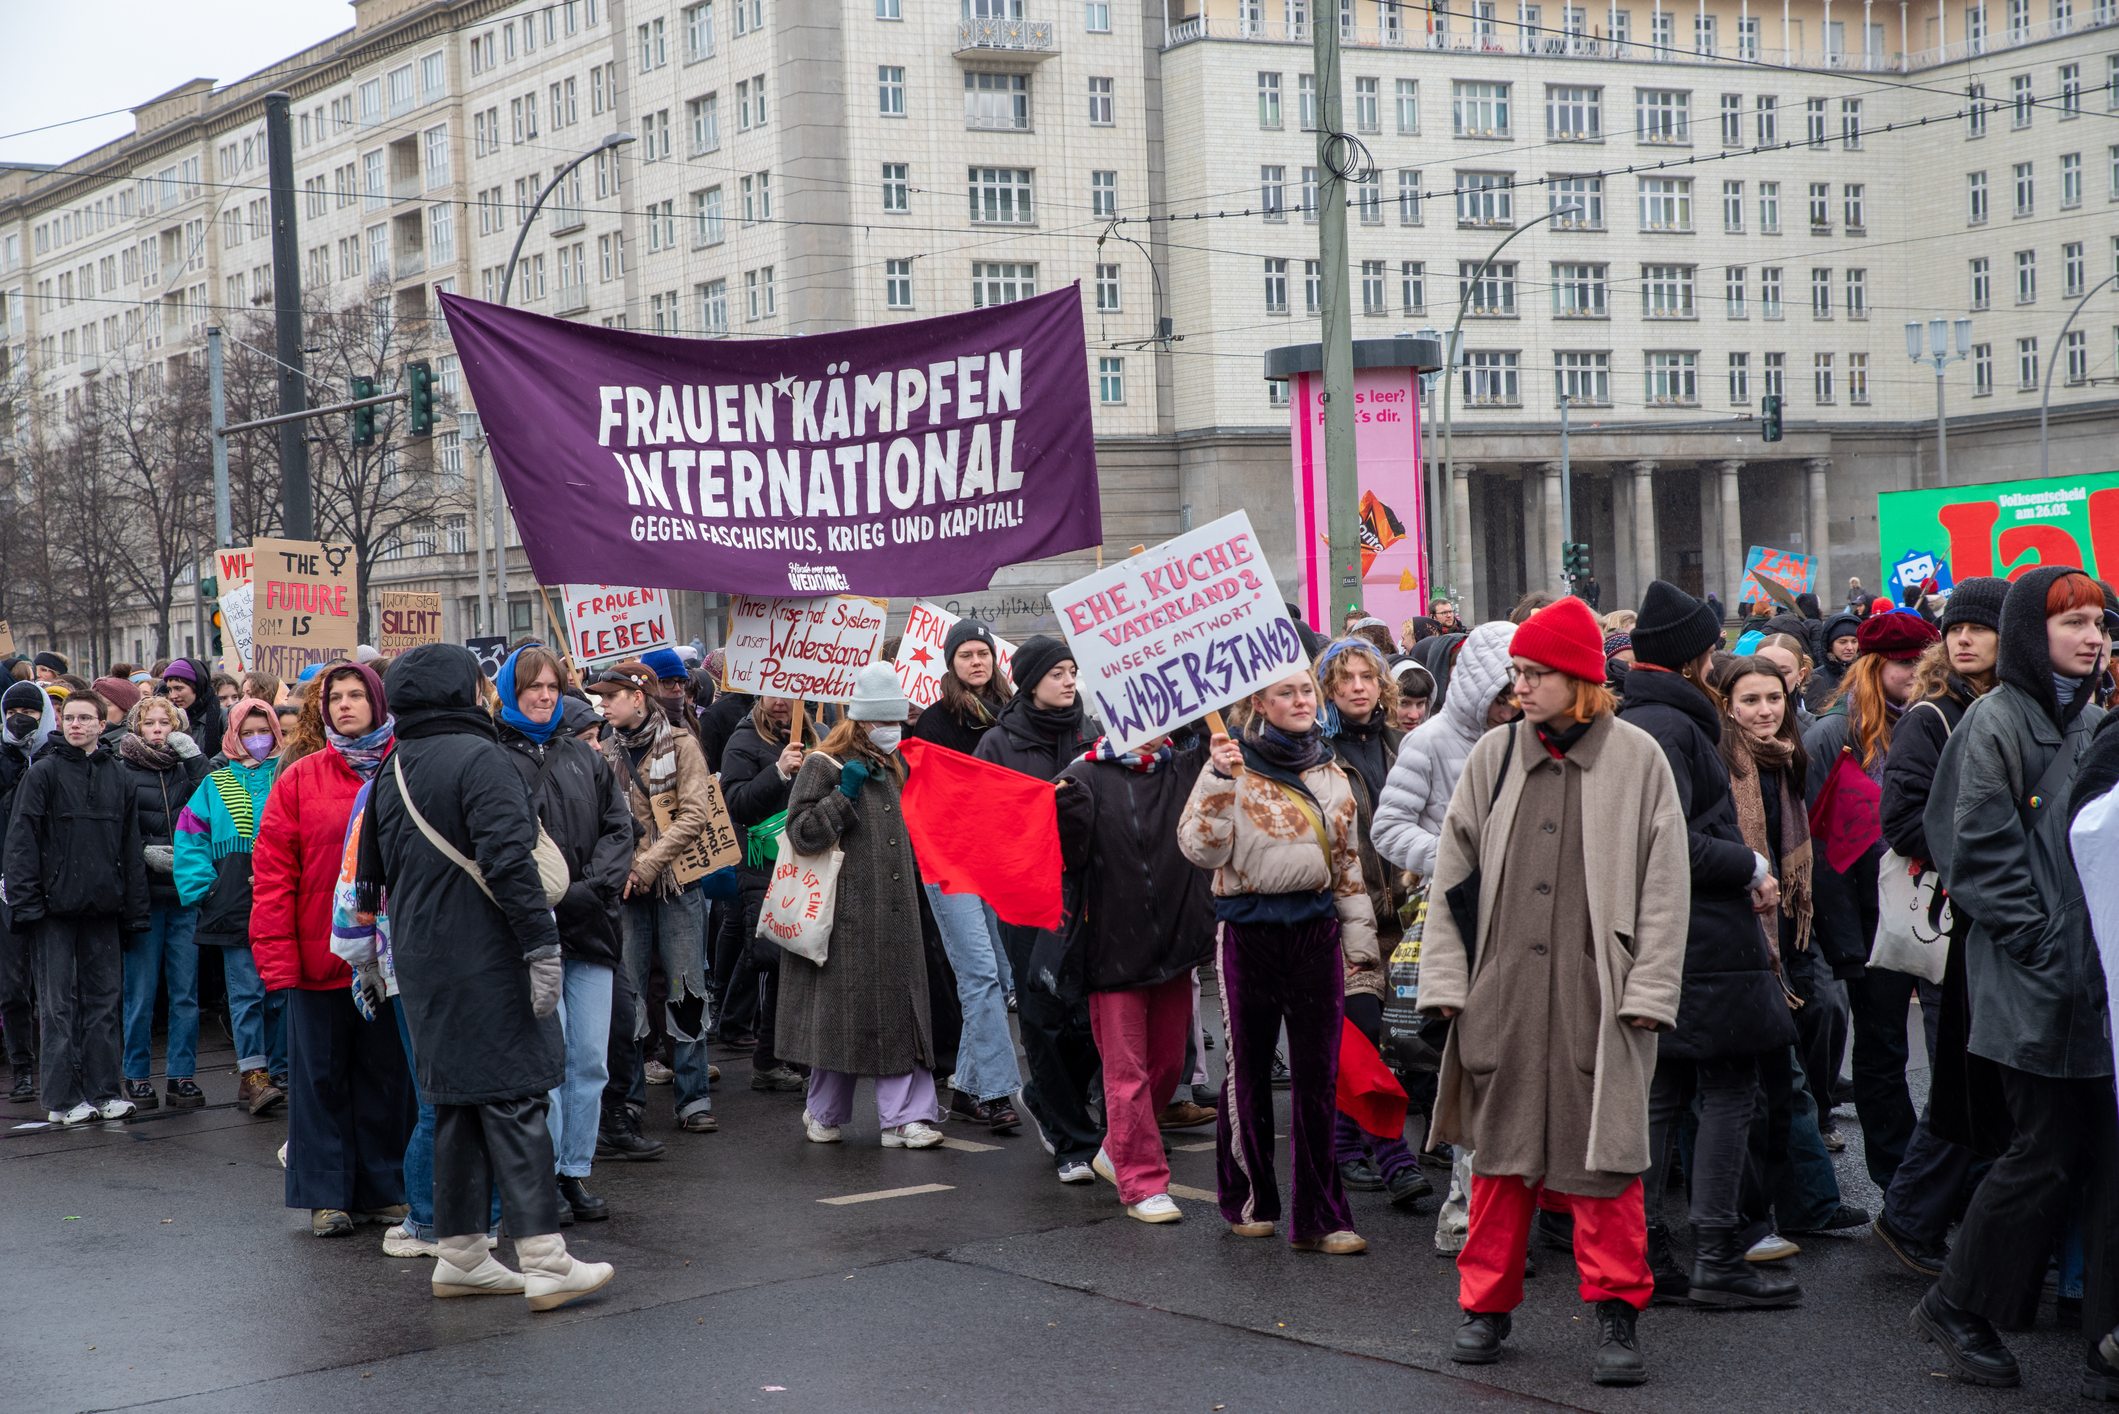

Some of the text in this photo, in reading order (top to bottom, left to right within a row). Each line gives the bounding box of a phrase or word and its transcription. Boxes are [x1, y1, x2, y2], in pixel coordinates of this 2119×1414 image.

[598, 348, 1022, 446] FRAUEN KÄMPFEN
[1370, 389, 1405, 403] leer?
[1376, 409, 1401, 422] dir.
[612, 419, 1024, 518] INTERNATIONAL
[1999, 487, 2086, 507] Volksentscheid
[2015, 503, 2071, 520] am 26.03.
[630, 499, 1023, 554] GEGEN FASCHISMUS, KRIEG UND KAPITAL!
[279, 552, 319, 575] THE
[1754, 549, 1809, 579] ZAN
[788, 573, 848, 591] WEDDING!
[1064, 533, 1254, 636] EHE, KÜCHE
[226, 597, 240, 612] das
[267, 581, 348, 616] FUTURE
[415, 595, 439, 612] stay
[577, 588, 654, 618] FRAUEN
[1099, 569, 1263, 646] VATERLAND?
[381, 610, 441, 634] SILENT
[612, 612, 628, 622] DIE
[738, 595, 880, 630] Ihre Krise hat System
[292, 616, 312, 636] IS
[581, 614, 665, 657] LEBEN
[402, 636, 417, 647] can
[737, 619, 877, 668] unser Widerstand
[1101, 601, 1252, 679] UNSERE ANTWORT
[732, 660, 753, 681] hat
[706, 822, 722, 856] what
[718, 825, 735, 850] tell
[777, 863, 798, 880] ERDE
